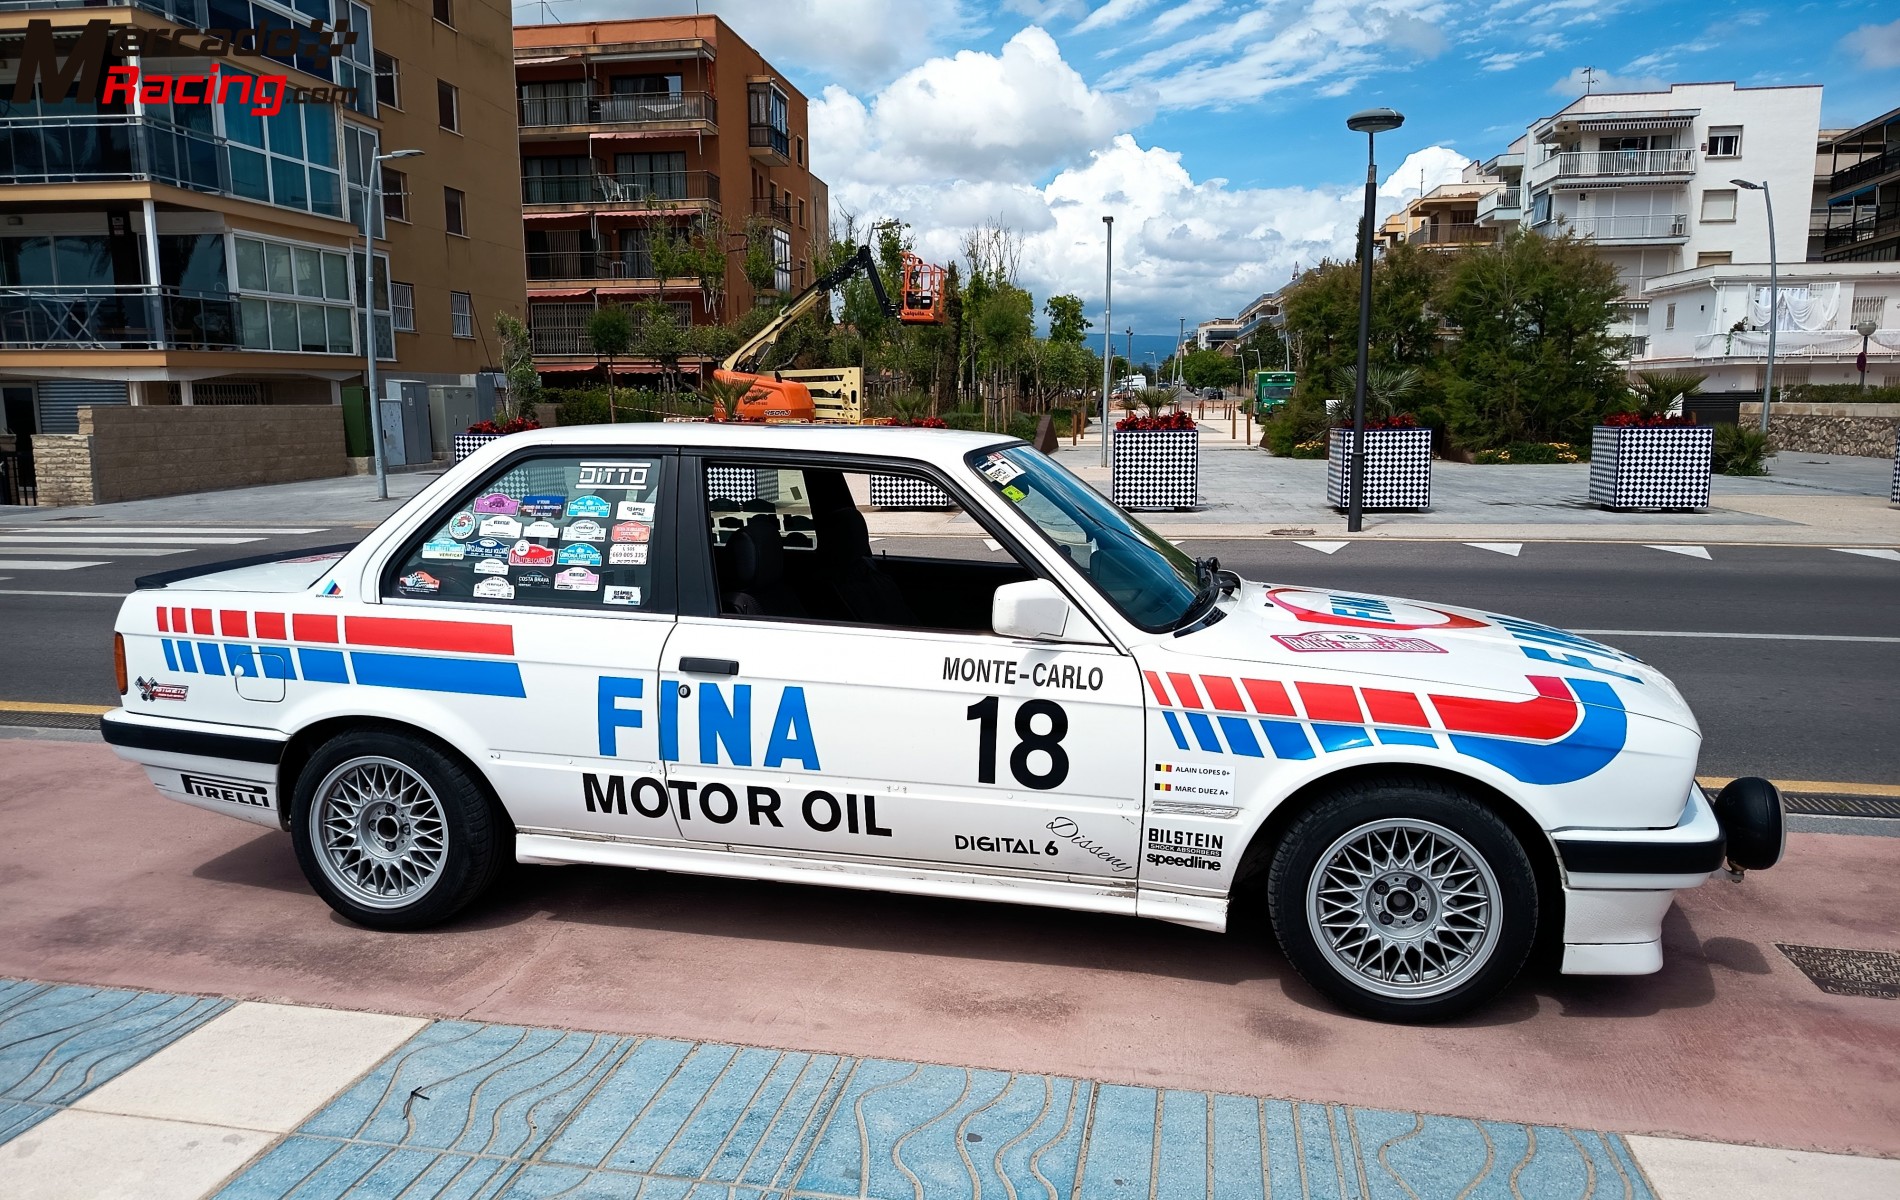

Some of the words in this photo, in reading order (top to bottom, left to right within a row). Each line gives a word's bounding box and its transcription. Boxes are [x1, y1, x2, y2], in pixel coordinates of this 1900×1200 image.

[943, 656, 1103, 691] MONTE-CARLO
[597, 676, 821, 771] FINA
[967, 695, 1070, 790] 18
[1175, 766, 1198, 774] ALAIN
[1198, 768, 1221, 776] LOPES
[181, 774, 270, 808] PIRELLI
[1175, 785, 1197, 794] MARC
[1198, 787, 1218, 795] DUEZ
[582, 772, 784, 828] MOTOR
[801, 790, 893, 838] OIL
[954, 834, 1040, 855] DIGITAL
[1044, 840, 1059, 856] 6
[1045, 816, 1132, 873] Disseny
[1148, 828, 1223, 849] BILSTEIN
[1150, 843, 1175, 852] SHOCK
[1176, 846, 1221, 857] ABSORBERS
[1146, 853, 1222, 871] speedline
